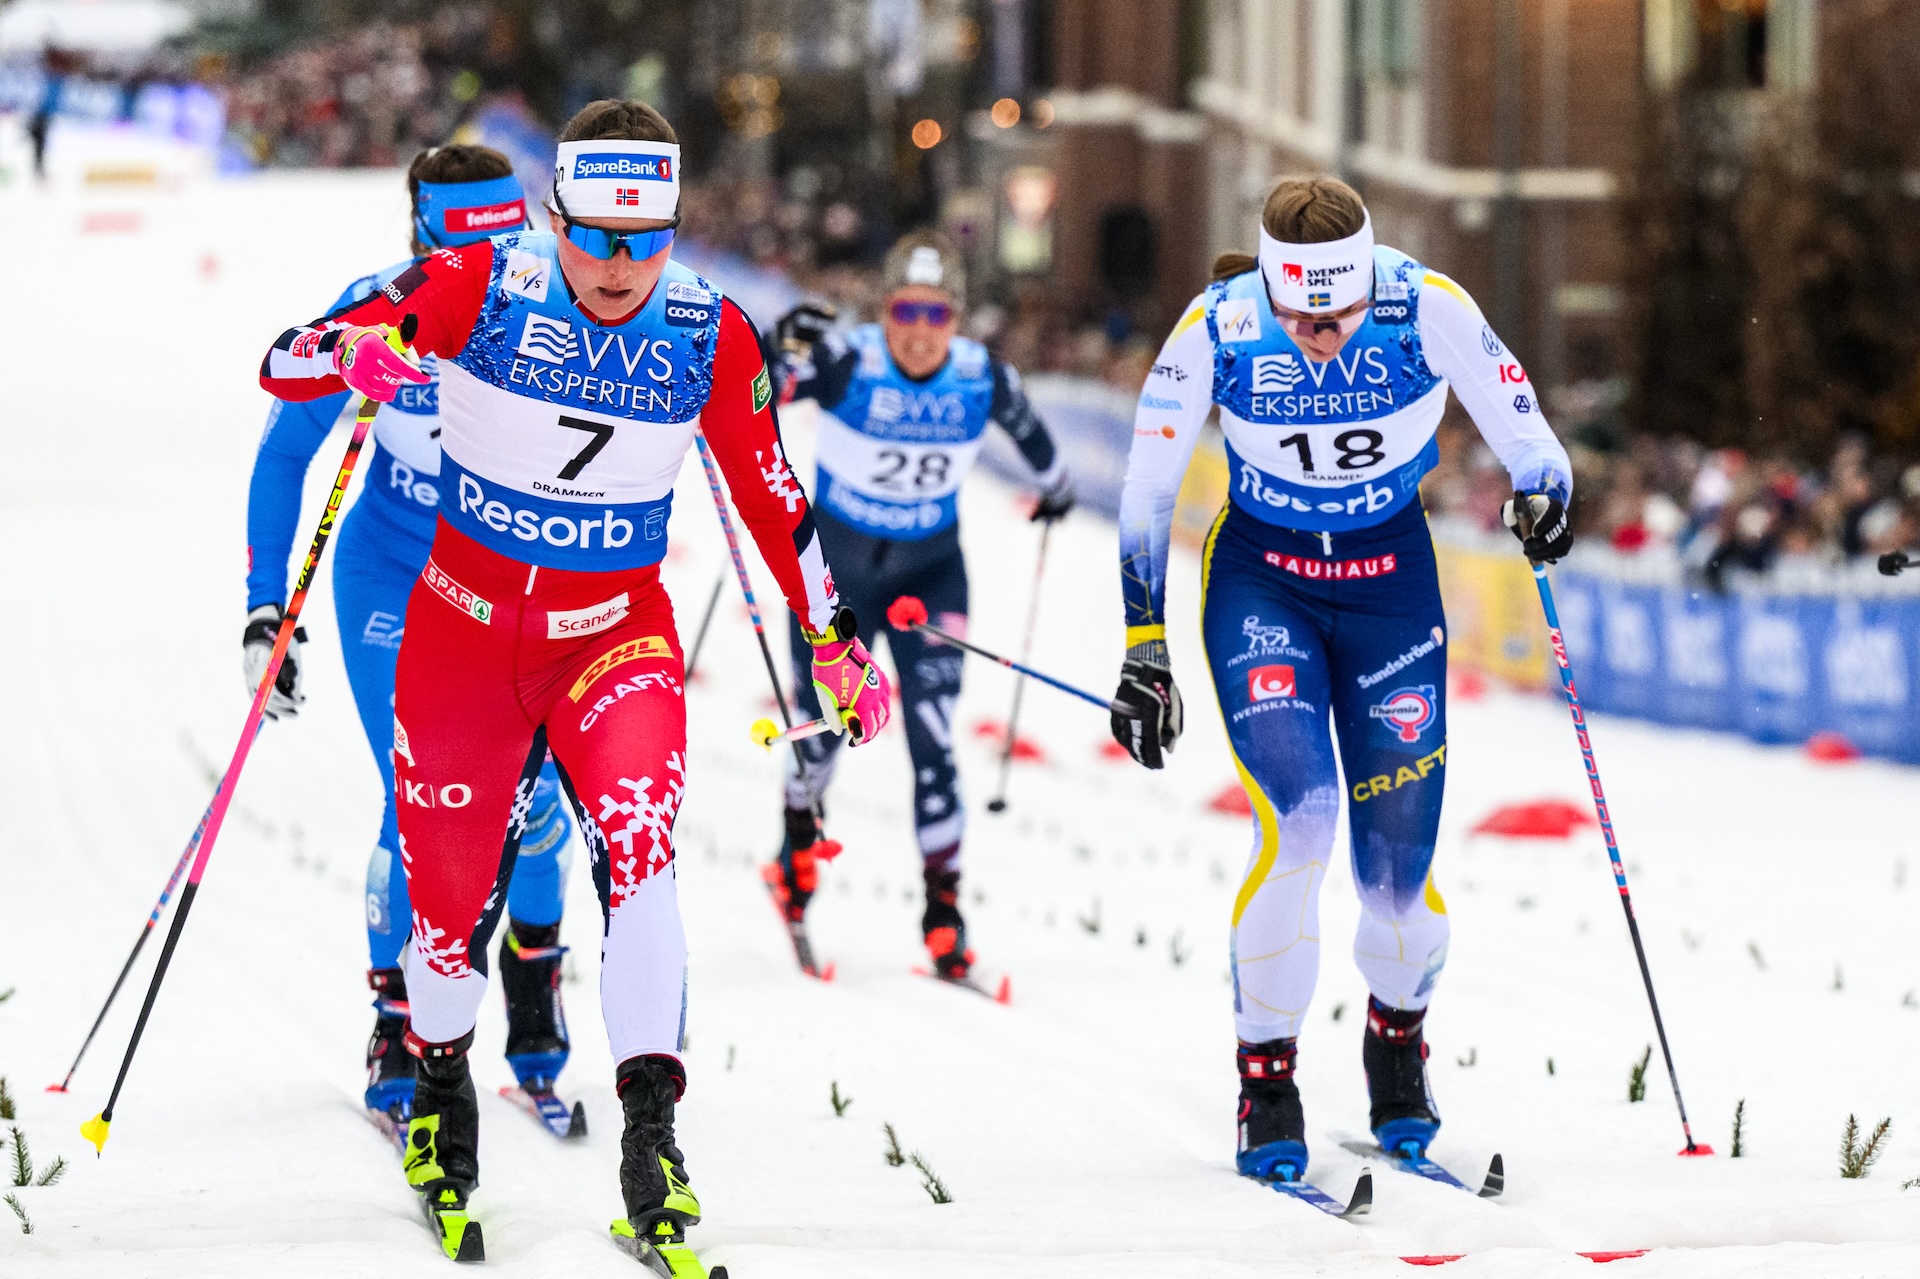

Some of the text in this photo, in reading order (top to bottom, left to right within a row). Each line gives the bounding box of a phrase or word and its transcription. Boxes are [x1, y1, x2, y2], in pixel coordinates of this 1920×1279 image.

[576, 158, 658, 177] SpareBank
[1307, 263, 1355, 278] SVENSKA
[1307, 277, 1335, 287] SPEL
[667, 306, 709, 322] coop
[1374, 305, 1407, 319] coop
[582, 327, 673, 382] VVS
[1302, 346, 1388, 389] VVS
[1499, 364, 1530, 383] IC
[509, 359, 672, 413] EKSPERTEN
[1251, 388, 1394, 417] EKSPERTEN
[557, 415, 615, 481] 7
[1280, 429, 1386, 472] 18
[872, 450, 951, 488] 28
[1303, 472, 1364, 481] DRAMMEN
[318, 468, 353, 536] LEKI
[532, 481, 606, 498] DRAMMEN
[1240, 463, 1394, 515] Resorb
[459, 472, 634, 549] Resorb
[427, 565, 472, 611] SPAR
[582, 641, 659, 687] DHL
[1227, 646, 1310, 668] novo nordisk
[1356, 640, 1435, 689] Sundström
[579, 672, 668, 732] CRAFT
[841, 664, 850, 703] LEKI
[1233, 699, 1316, 723] SVENSKA SPEL
[1371, 704, 1420, 717] Thermia
[1353, 747, 1447, 803] CRAFT
